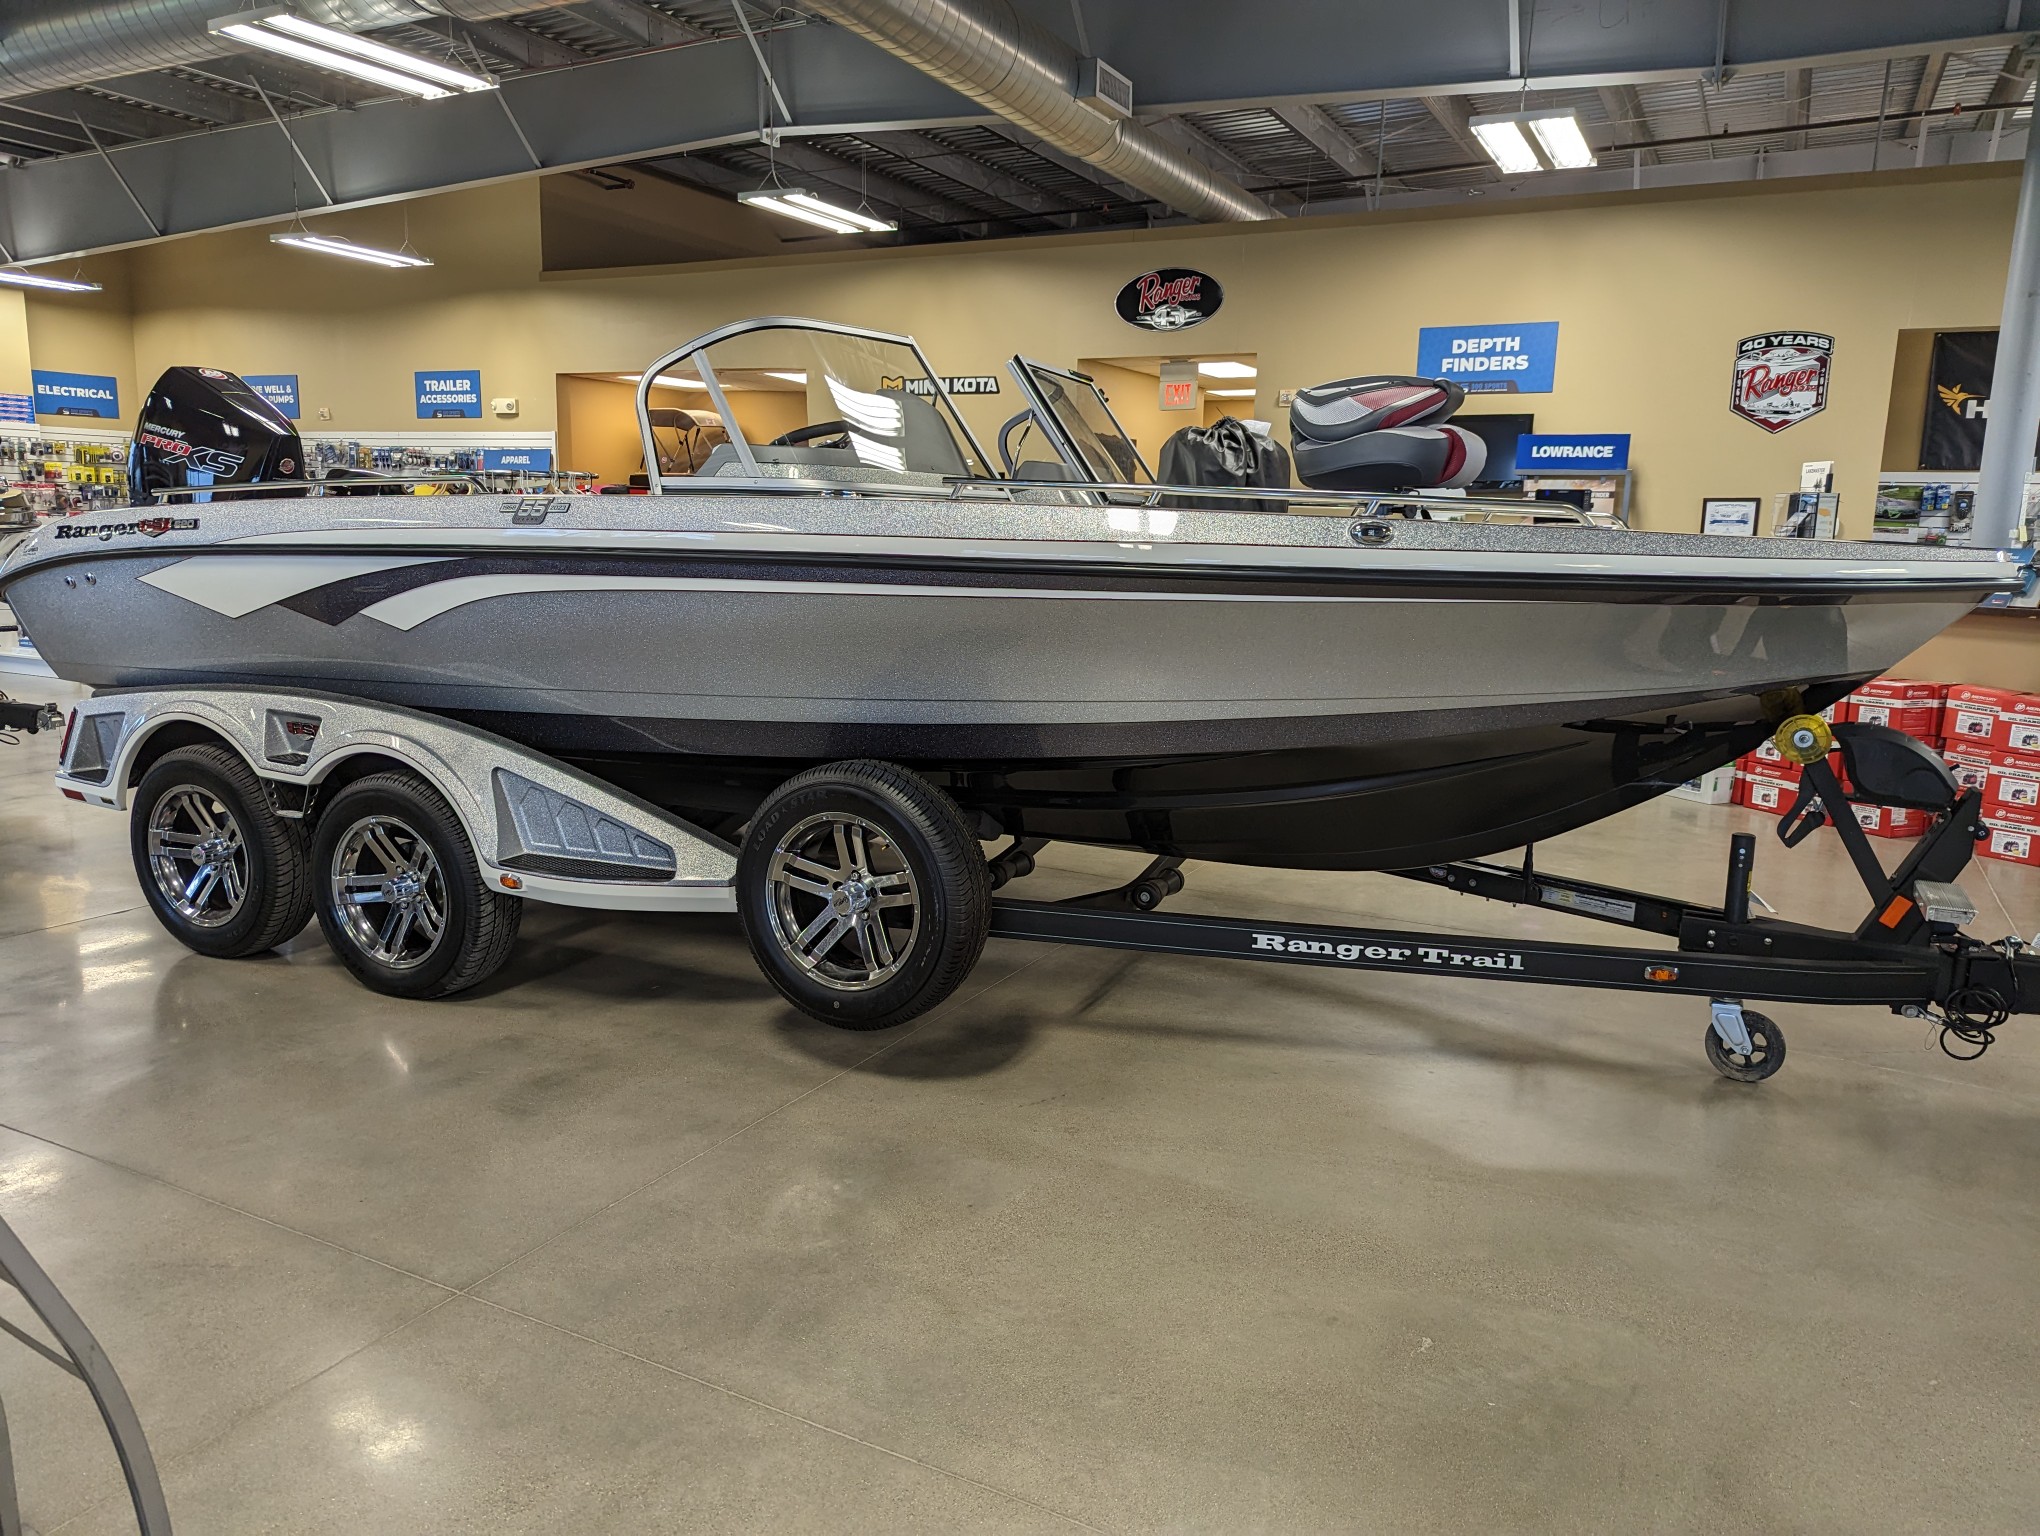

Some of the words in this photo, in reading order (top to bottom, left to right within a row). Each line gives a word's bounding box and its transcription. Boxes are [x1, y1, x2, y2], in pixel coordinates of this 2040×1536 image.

[1137, 273, 1201, 313] Ranger
[1452, 336, 1520, 354] DEPTH
[1742, 340, 1766, 351] 40
[1769, 335, 1830, 349] YEARS
[1441, 355, 1529, 373] FINDERS
[264, 385, 285, 394] WELL
[285, 385, 292, 393] &
[424, 379, 471, 392] TRAILER
[905, 379, 949, 394] MINN
[953, 377, 998, 392] KOTA
[1742, 364, 1818, 402] Ranger
[37, 384, 114, 400] ELECTRICAL
[268, 395, 294, 404] PUMPS
[419, 394, 477, 404] ACCESSORIES
[1165, 383, 1192, 406] EXIT
[144, 422, 186, 438] MERCURY
[140, 433, 192, 455] PRO
[1532, 446, 1614, 457] LOWRANCE
[163, 446, 245, 477] XS
[501, 456, 530, 464] APPAREL
[518, 500, 549, 516] 55
[54, 522, 138, 541] Ranger
[1971, 694, 1998, 702] MERCURY
[1967, 747, 1992, 755] MERCURY
[2007, 812, 2035, 821] MERCURY
[1252, 934, 1411, 961] Ranger
[1417, 947, 1525, 970] Trail
